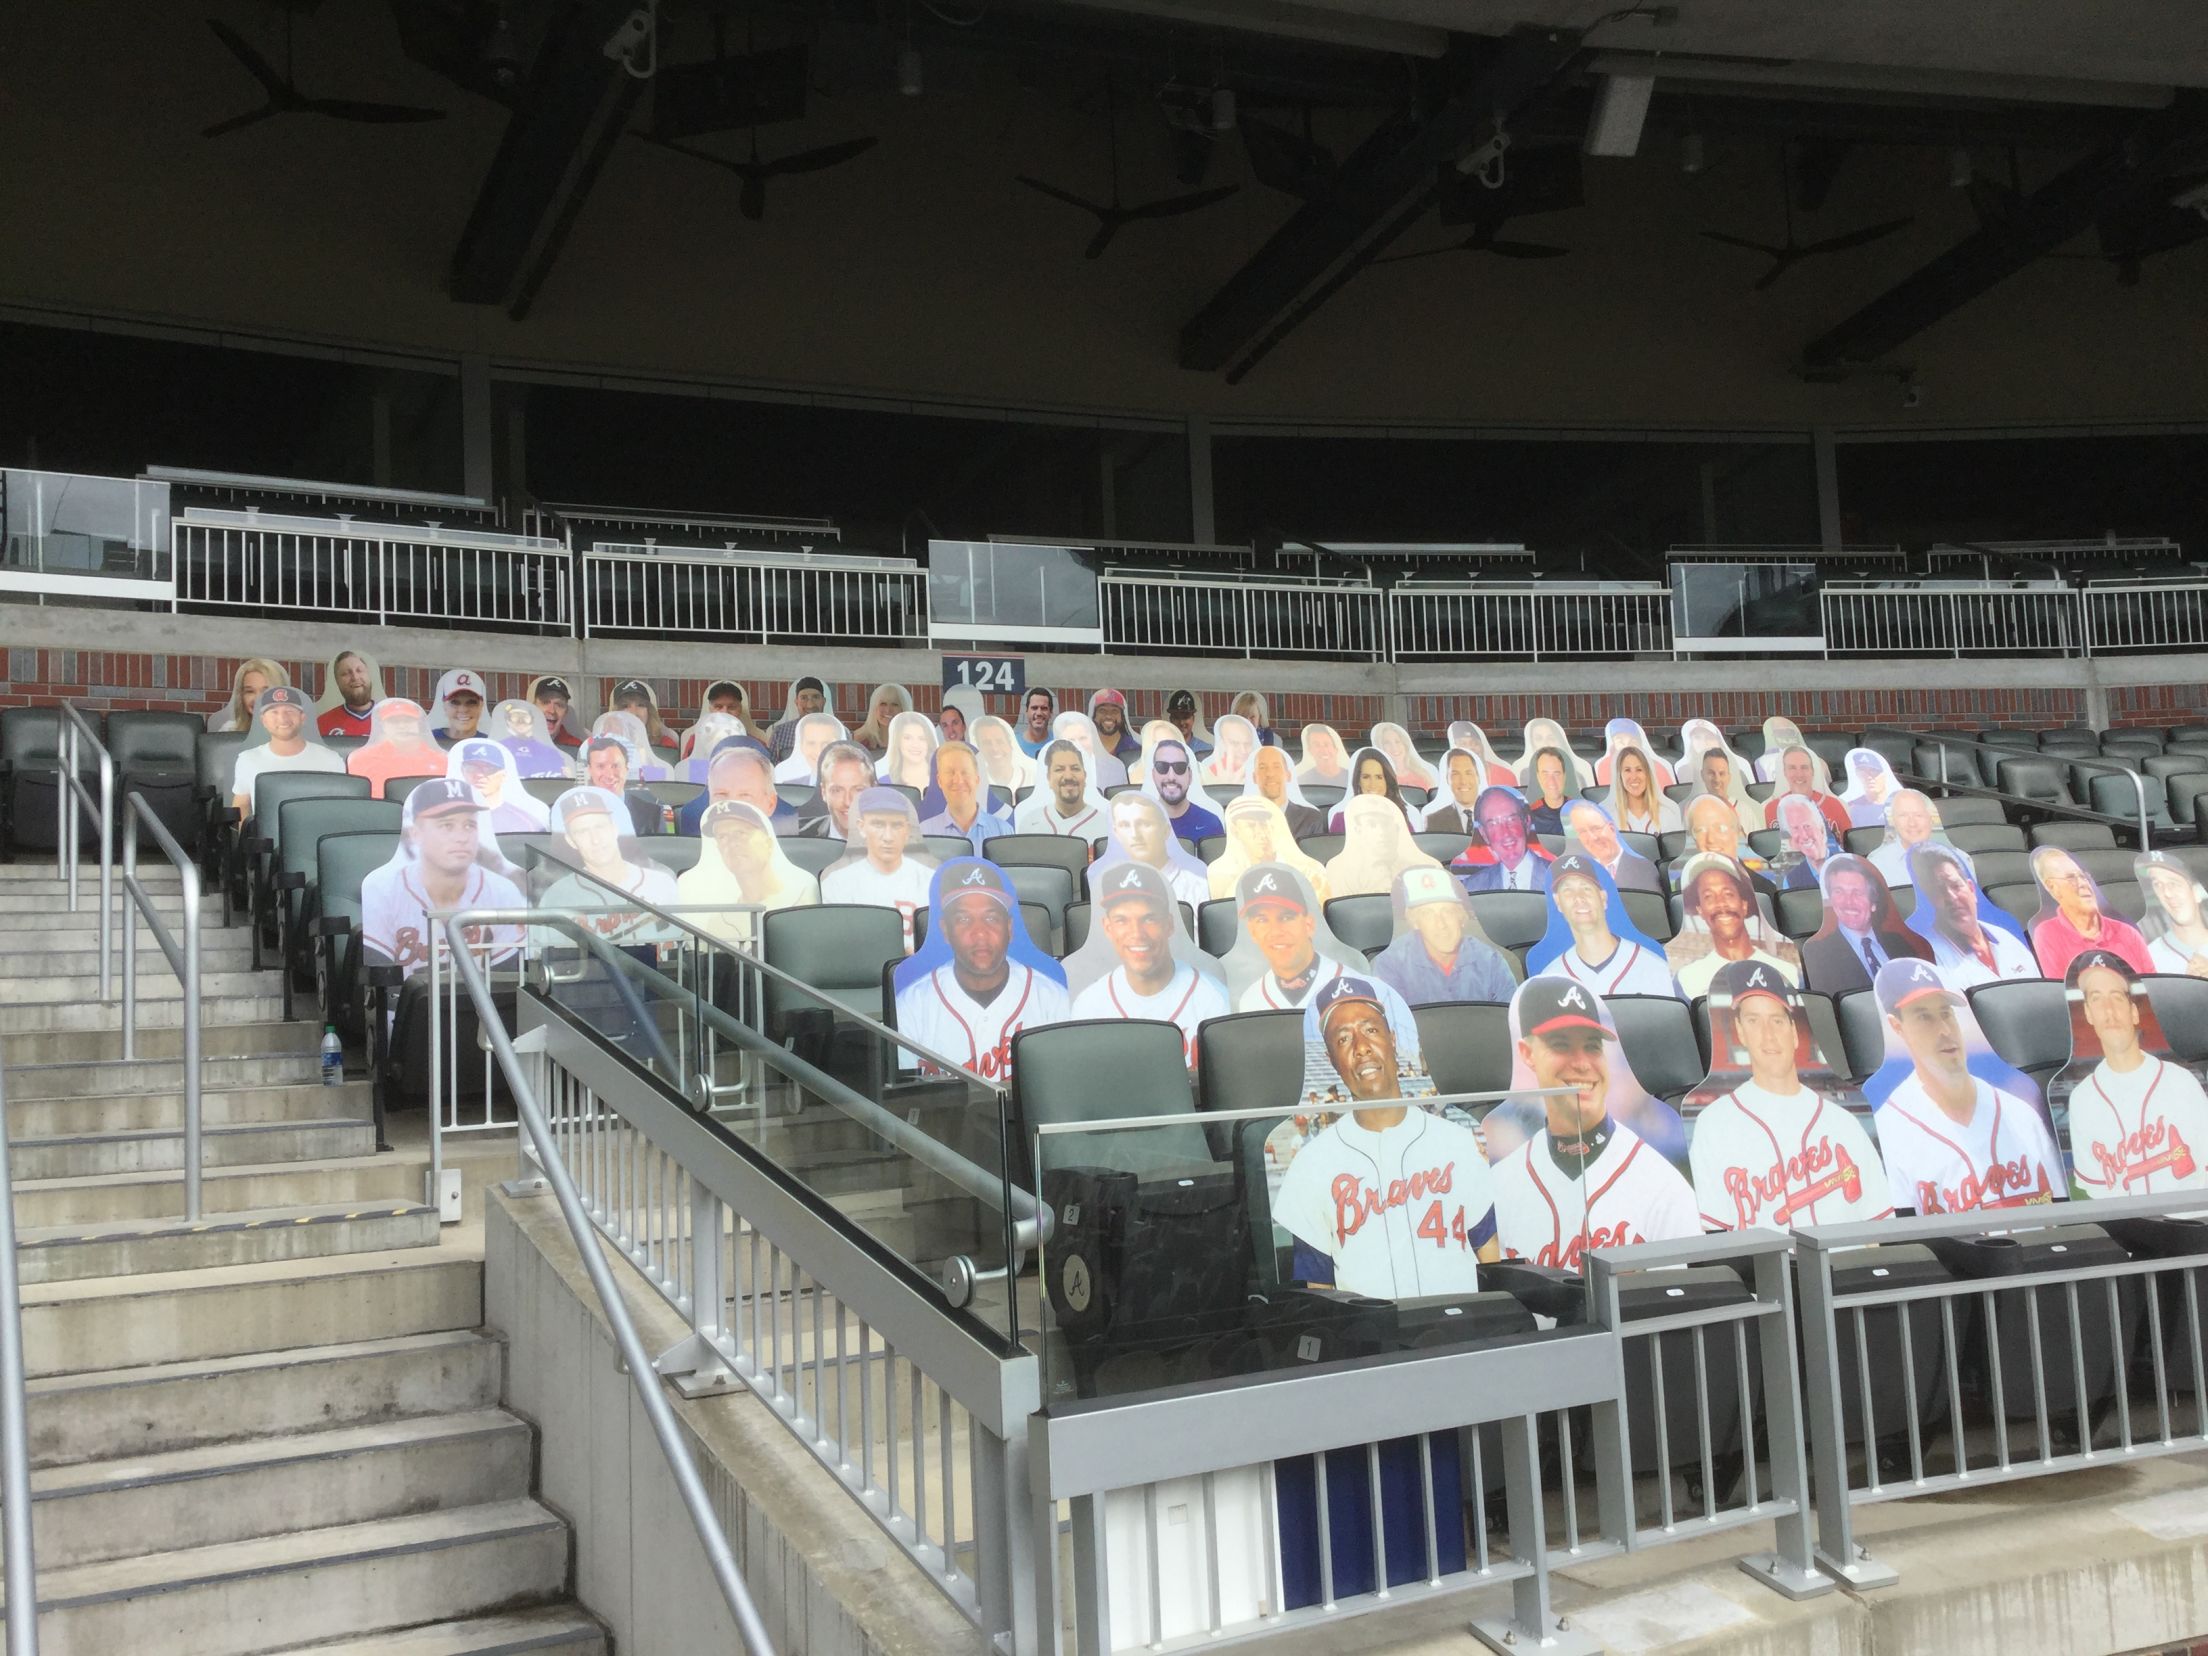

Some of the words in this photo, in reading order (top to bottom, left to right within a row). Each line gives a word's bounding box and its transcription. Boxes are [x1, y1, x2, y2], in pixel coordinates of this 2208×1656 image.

[957, 661, 1015, 691] 124
[444, 781, 464, 798] M
[574, 793, 589, 808] M
[716, 801, 731, 815] M
[1561, 855, 1580, 870] A
[962, 867, 985, 886] A
[1119, 869, 1142, 888] A
[1253, 872, 1277, 893] A
[2089, 954, 2106, 968] A
[1746, 967, 1768, 987] A
[1910, 964, 1934, 983] A
[1331, 977, 1354, 999] A
[1558, 985, 1586, 1010] A
[2092, 1115, 2165, 1190] Braves
[1724, 1135, 1832, 1232] Braves
[1915, 1154, 2032, 1216] Braves
[1331, 1161, 1455, 1249] Braves
[1067, 1209, 1076, 1222] 2
[1417, 1200, 1467, 1252] 44
[1068, 1270, 1085, 1297] A
[1306, 1341, 1313, 1356] 1
